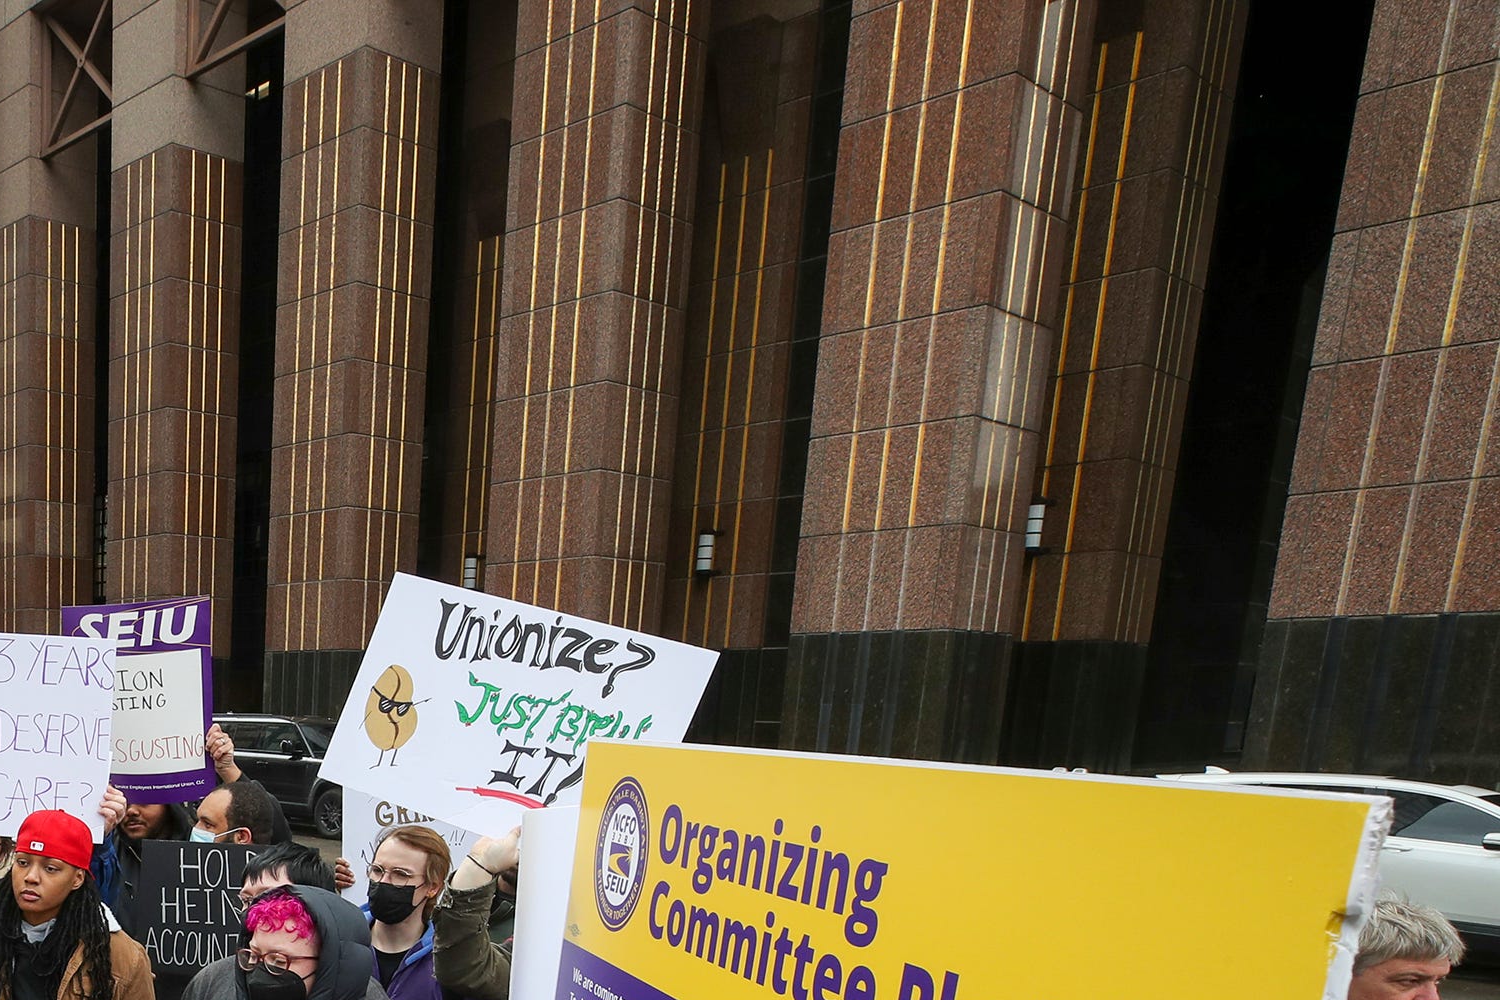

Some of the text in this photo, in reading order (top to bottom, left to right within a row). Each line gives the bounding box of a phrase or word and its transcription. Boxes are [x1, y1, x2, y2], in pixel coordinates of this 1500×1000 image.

[80, 605, 198, 648] SEIU
[26, 639, 115, 690] YEARS
[114, 668, 164, 692] ION
[455, 671, 573, 746] JUST
[112, 733, 204, 763] SGUSTING
[612, 812, 636, 835] NCFO
[605, 873, 629, 896] SEIU
[659, 804, 888, 948] Organizing
[161, 887, 242, 926] HEIN
[572, 967, 583, 990] We
[581, 975, 595, 998] are
